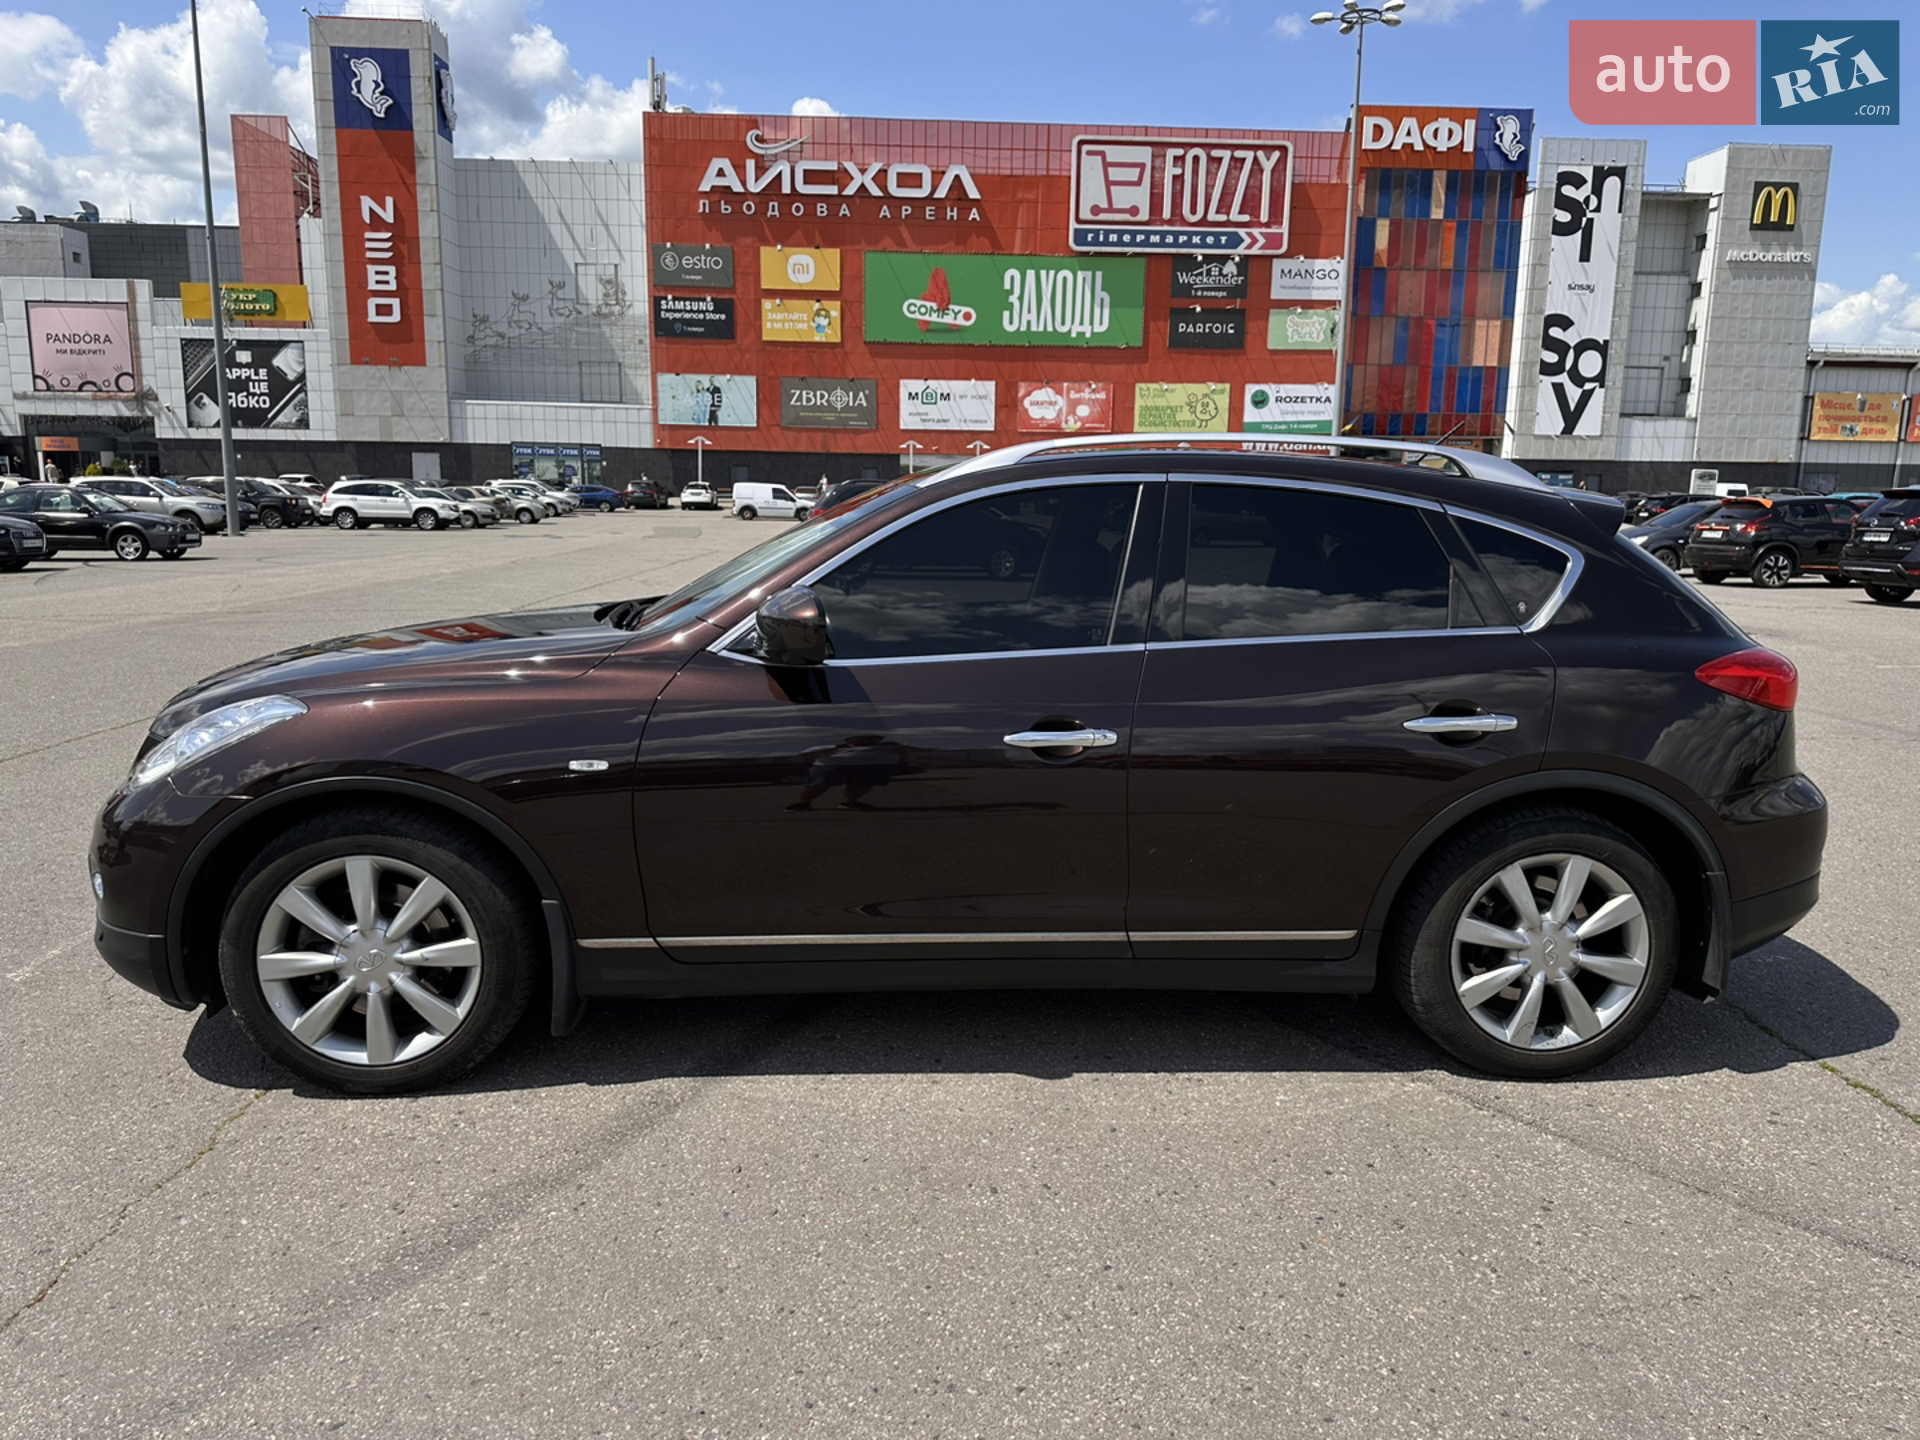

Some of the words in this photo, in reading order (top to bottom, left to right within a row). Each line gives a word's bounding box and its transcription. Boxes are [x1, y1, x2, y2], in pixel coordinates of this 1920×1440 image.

[1162, 147, 1281, 224] FOZZY
[698, 200, 852, 218] ЛЬОДОВА
[879, 204, 981, 222] АРЕНА
[1086, 230, 1229, 246] гіпермаркет
[682, 254, 723, 270] estro
[1726, 249, 1812, 264] McDonald's
[1176, 268, 1245, 285] Weekender
[1279, 268, 1340, 281] MANGO
[1567, 281, 1596, 294] sinsay
[660, 300, 715, 311] SAMSUNG
[1002, 268, 1110, 338] ЗАХОДЬ
[660, 311, 704, 320] Experience
[705, 312, 726, 321] Store
[906, 302, 962, 321] COMFY
[46, 331, 113, 345] PANDORA
[249, 381, 269, 394] ЦЕ
[1275, 395, 1332, 405] ROZETKA
[1138, 404, 1184, 413] ЗООМАРКЕТ
[1138, 412, 1177, 420] ПЕРНАТИХ
[1138, 419, 1197, 428] ОСОБИСТОСТЕЙ
